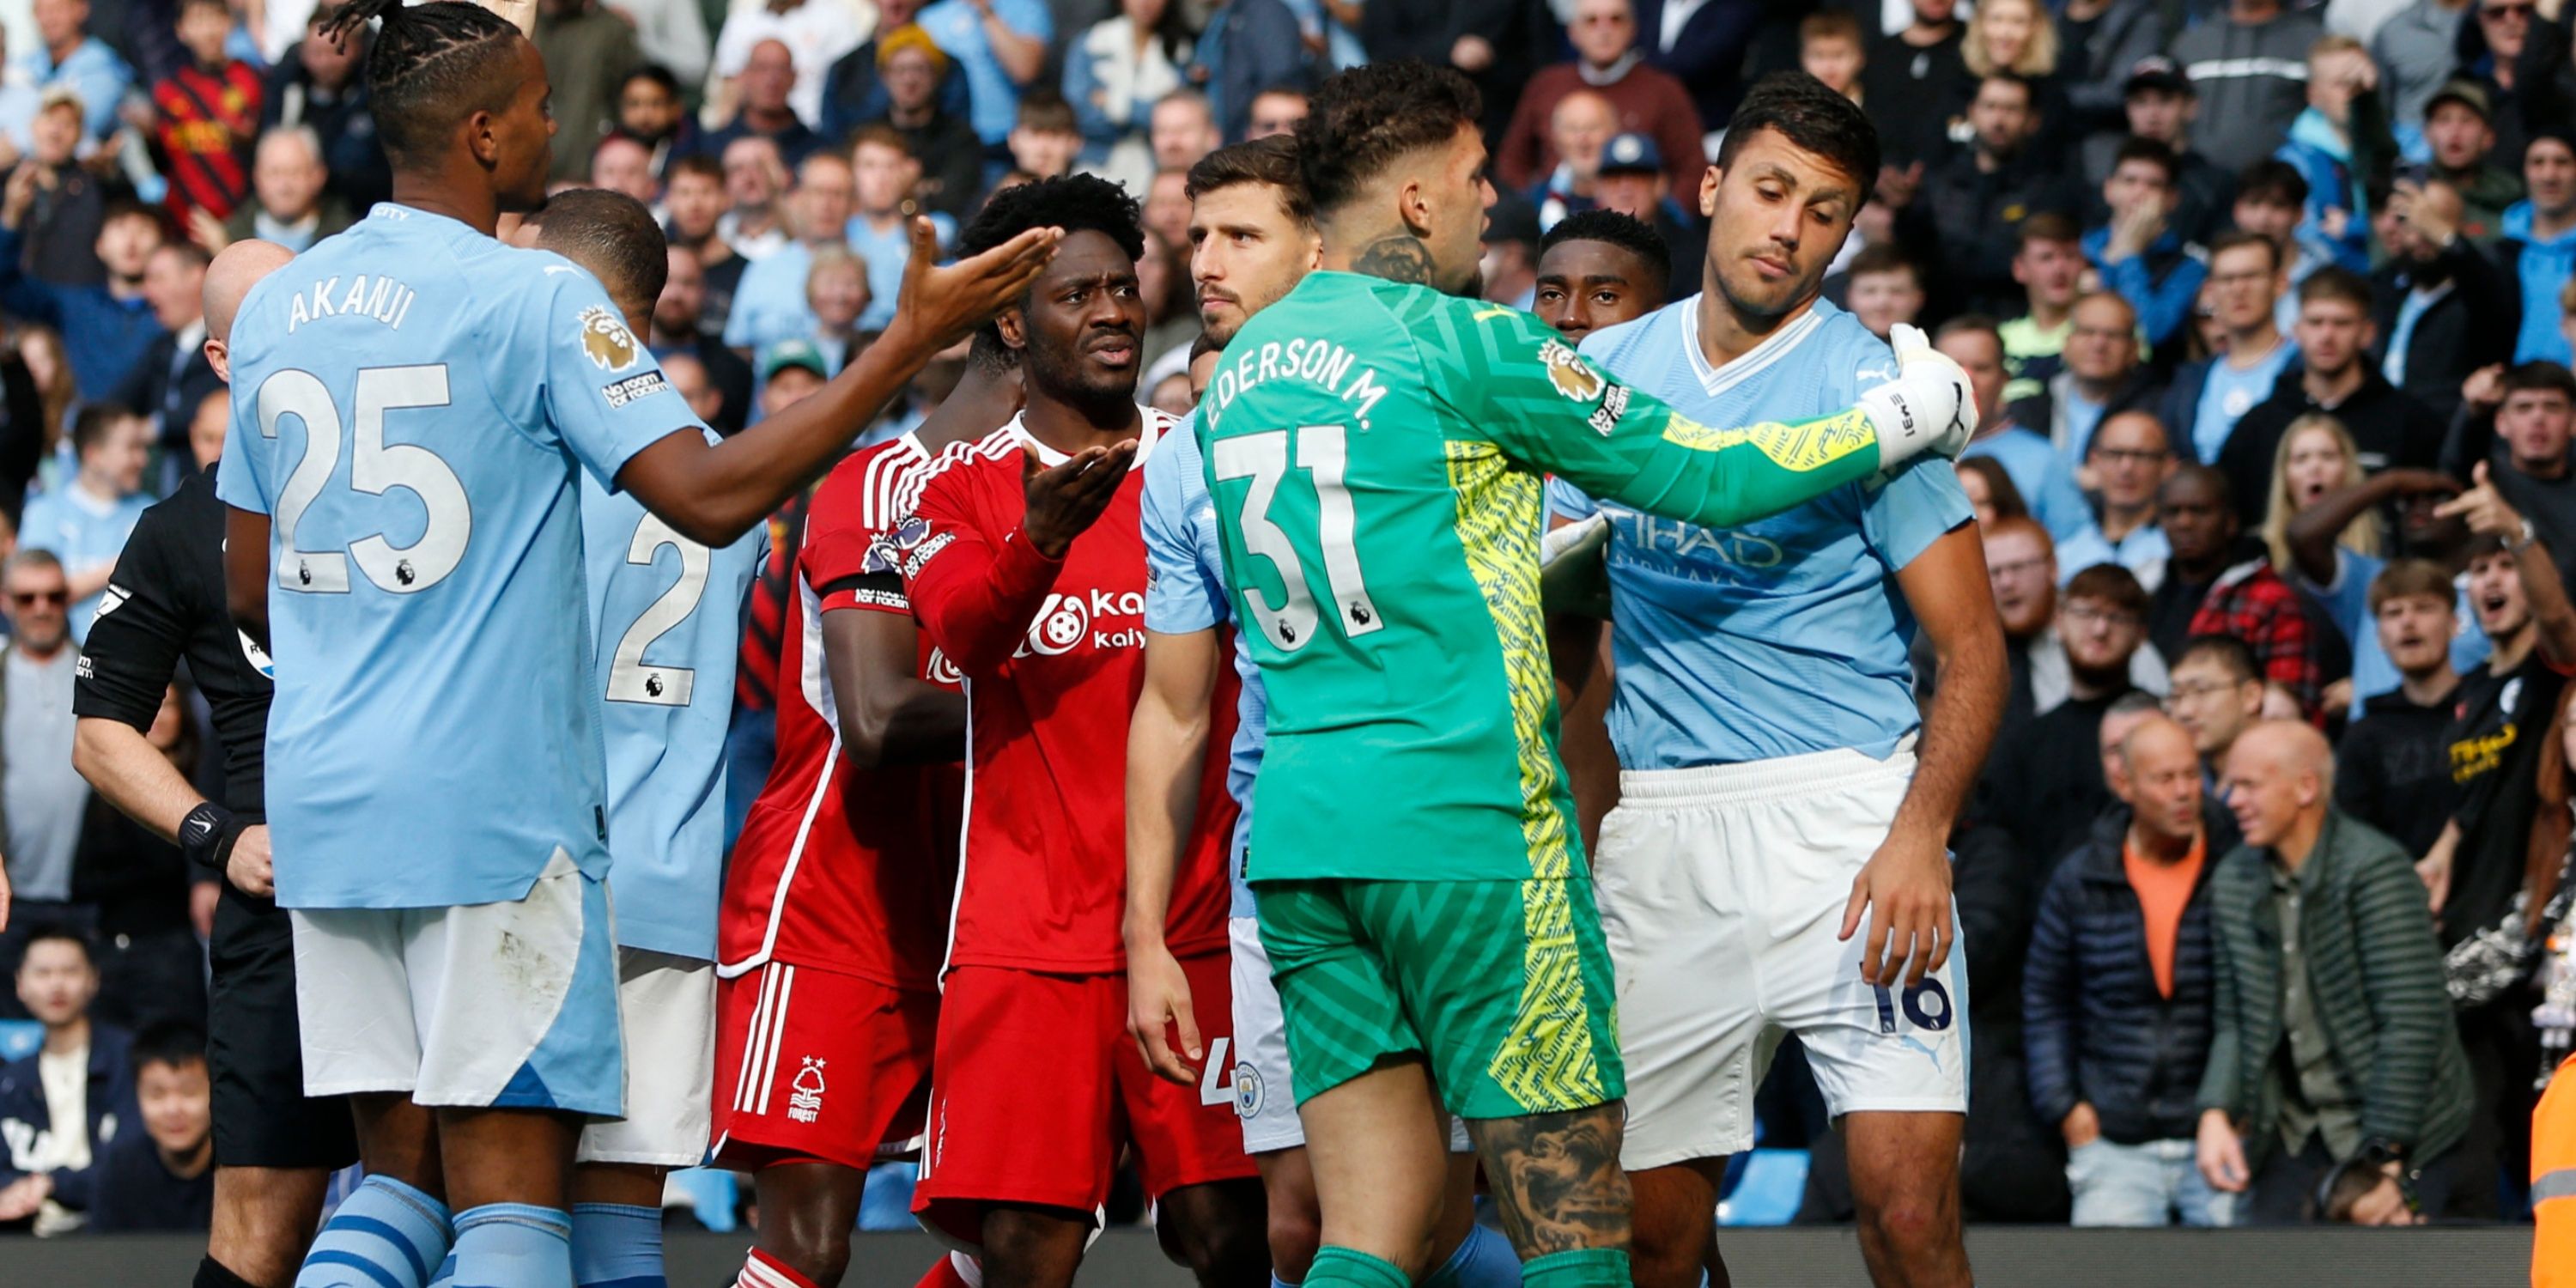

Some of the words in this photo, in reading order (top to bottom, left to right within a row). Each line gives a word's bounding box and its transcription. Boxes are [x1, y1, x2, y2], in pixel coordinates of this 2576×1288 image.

[288, 275, 416, 334] AKANJI
[602, 383, 625, 399] No
[622, 373, 659, 392] room
[606, 392, 629, 410] for
[627, 381, 669, 400] racism
[1206, 337, 1355, 432] EDERSON
[1341, 368, 1388, 430] M.
[1588, 408, 1608, 431] No
[1603, 385, 1618, 411] room
[1596, 415, 1615, 437] for
[1610, 386, 1631, 421] racism
[258, 362, 471, 594] 25
[904, 555, 917, 573] No
[914, 532, 951, 557] room
[905, 561, 920, 581] for
[917, 533, 957, 565] racism
[1212, 424, 1385, 653] 31
[605, 510, 712, 707] 2
[787, 1107, 818, 1123] FOREST
